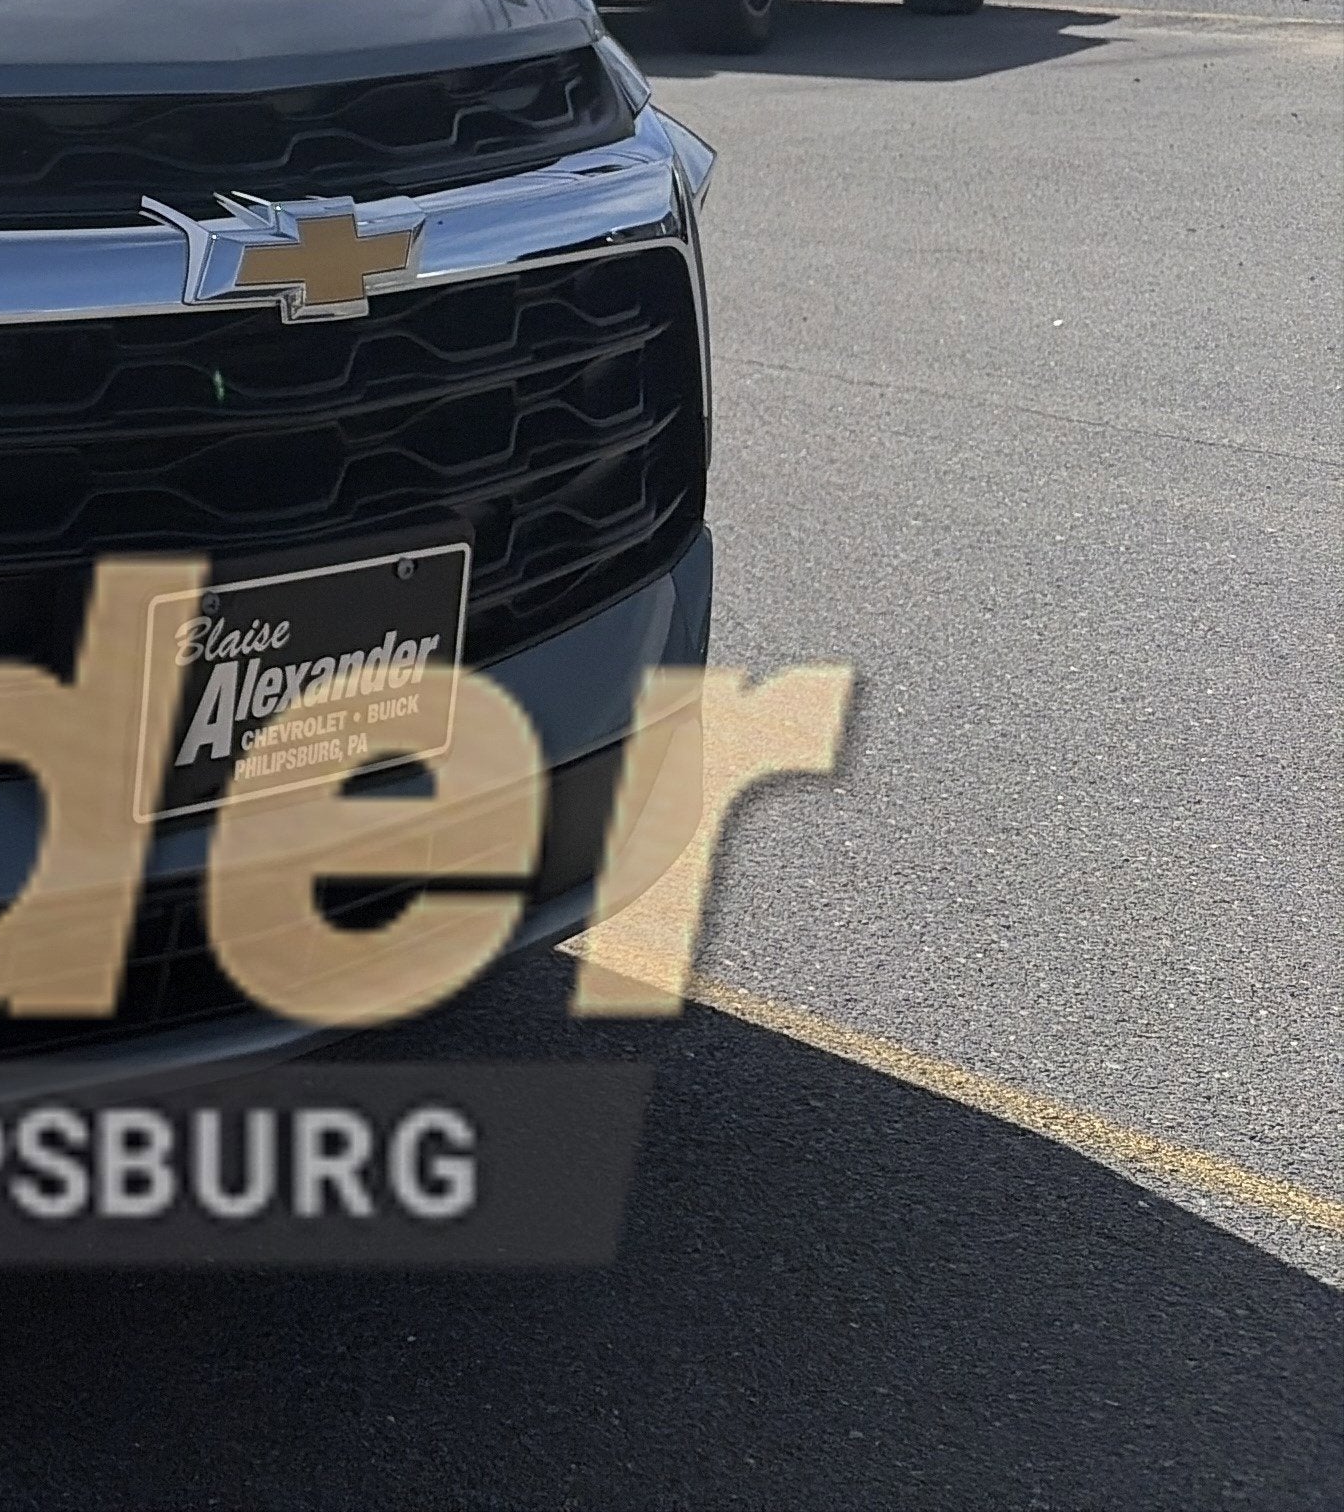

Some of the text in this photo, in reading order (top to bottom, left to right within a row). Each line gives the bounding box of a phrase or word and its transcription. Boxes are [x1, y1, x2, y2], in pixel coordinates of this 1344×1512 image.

[173, 615, 291, 667] Blaise
[173, 629, 441, 768] Alexander
[240, 693, 422, 752] CHEVROLET BUICK
[233, 731, 370, 783] PHILIPSBURG, PA
